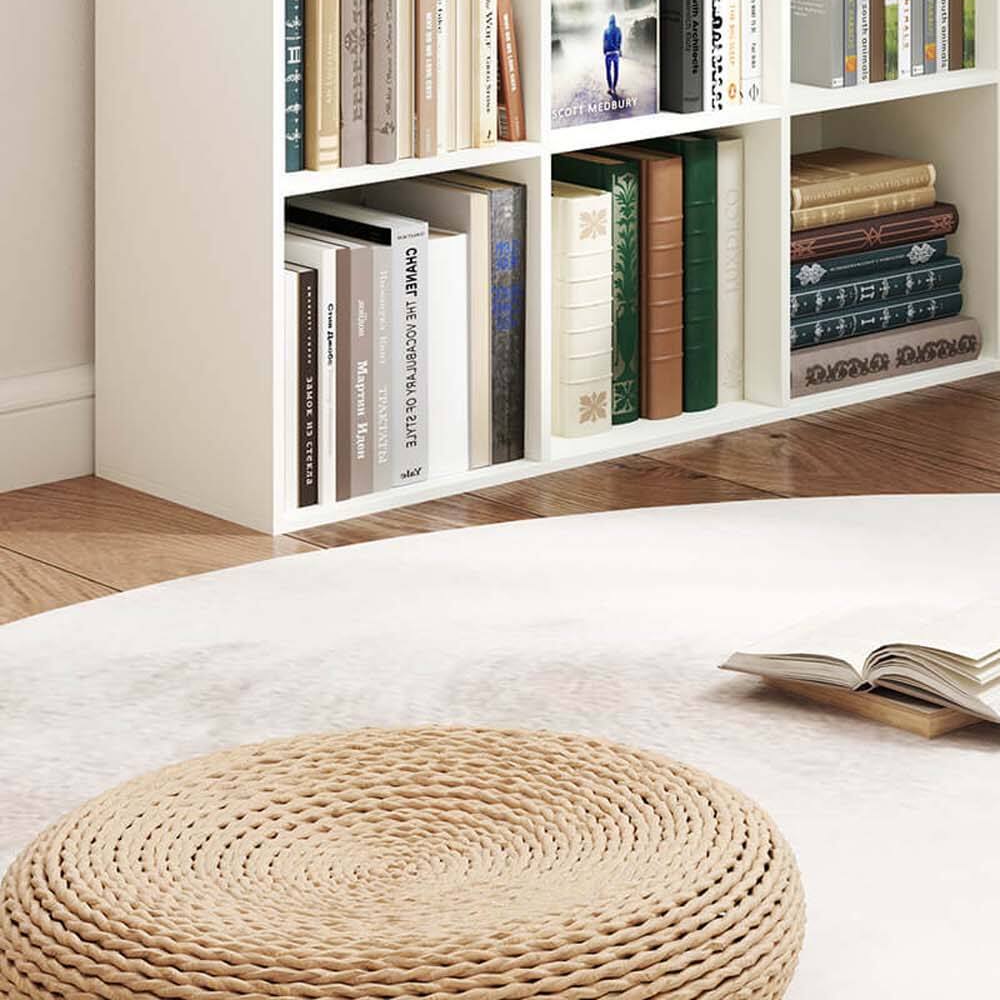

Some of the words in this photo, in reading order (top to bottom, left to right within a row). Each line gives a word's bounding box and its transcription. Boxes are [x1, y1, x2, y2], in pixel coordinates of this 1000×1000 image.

[692, 20, 700, 74] Architects
[552, 105, 583, 119] SCOTT
[587, 97, 637, 113] MEDBURY
[356, 360, 368, 416] Мартин
[356, 422, 369, 460] Иден
